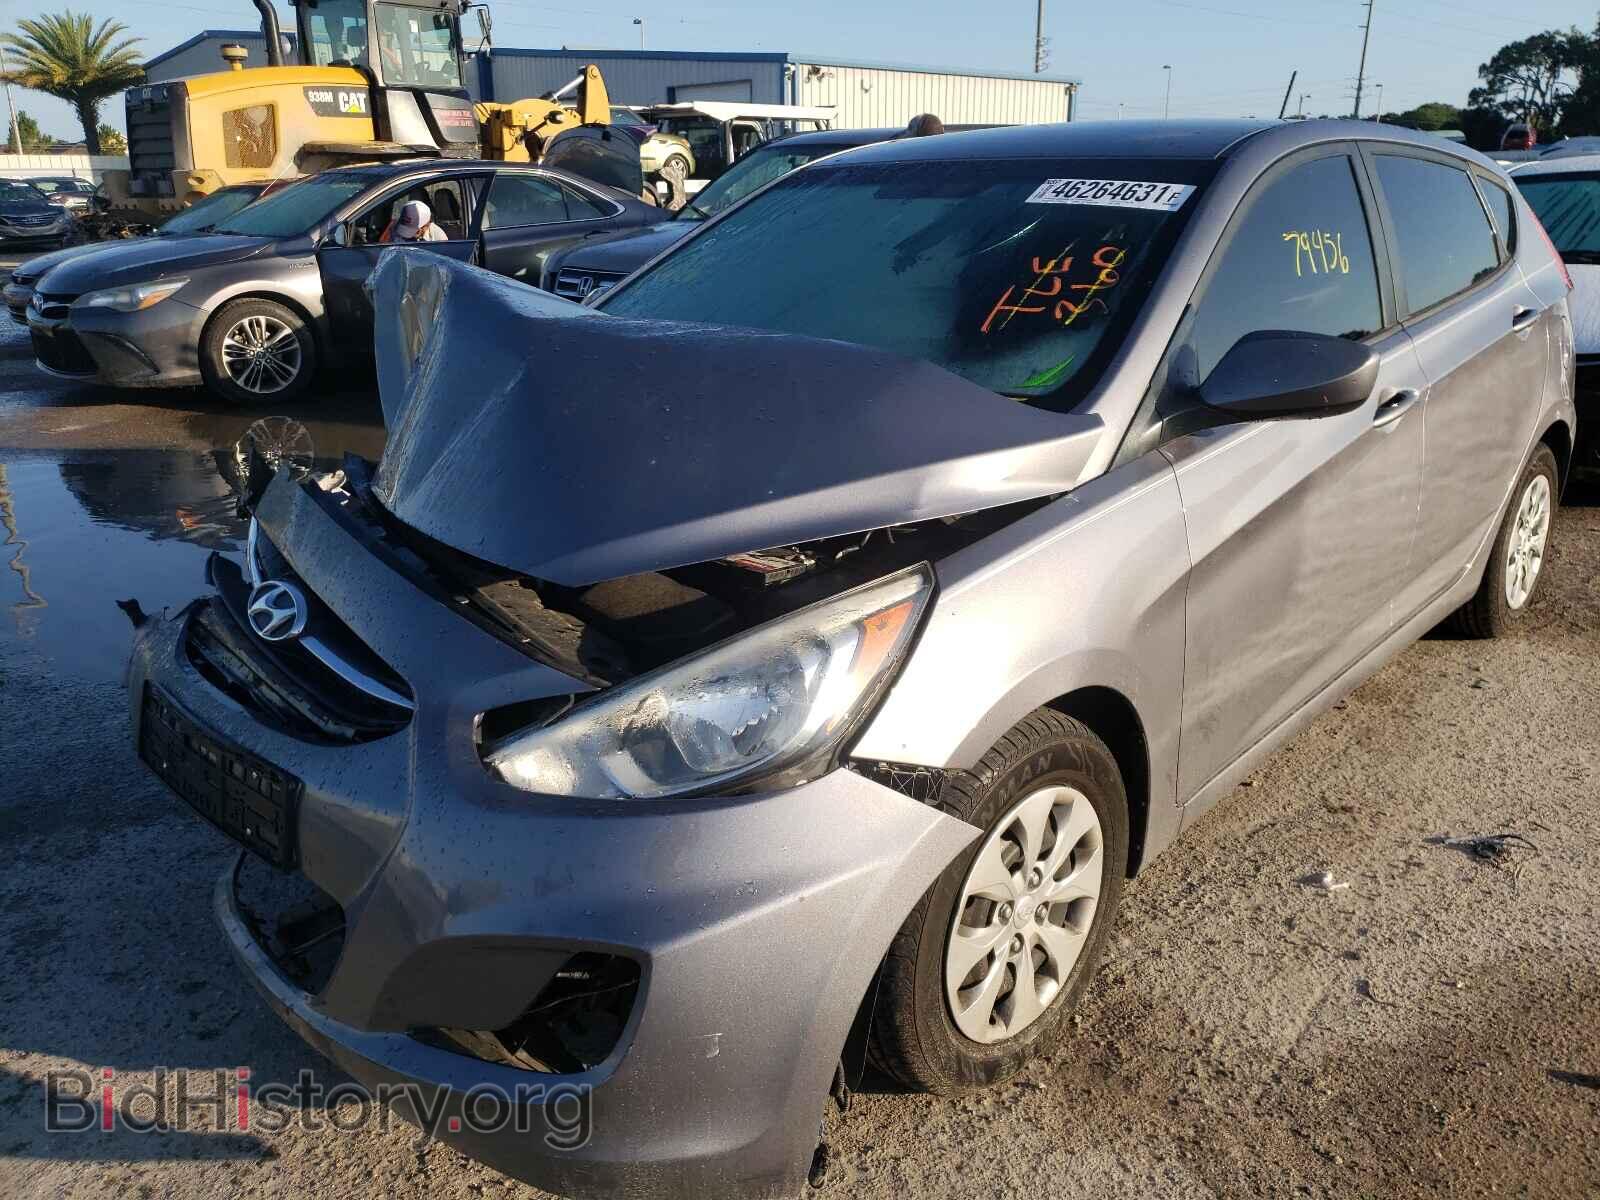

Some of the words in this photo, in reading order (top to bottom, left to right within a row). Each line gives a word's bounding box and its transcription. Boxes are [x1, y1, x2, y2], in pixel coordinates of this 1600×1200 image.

[308, 91, 334, 103] 938M
[338, 92, 366, 112] CAT
[1051, 180, 1171, 203] 46264631
[1281, 229, 1349, 277] 79456
